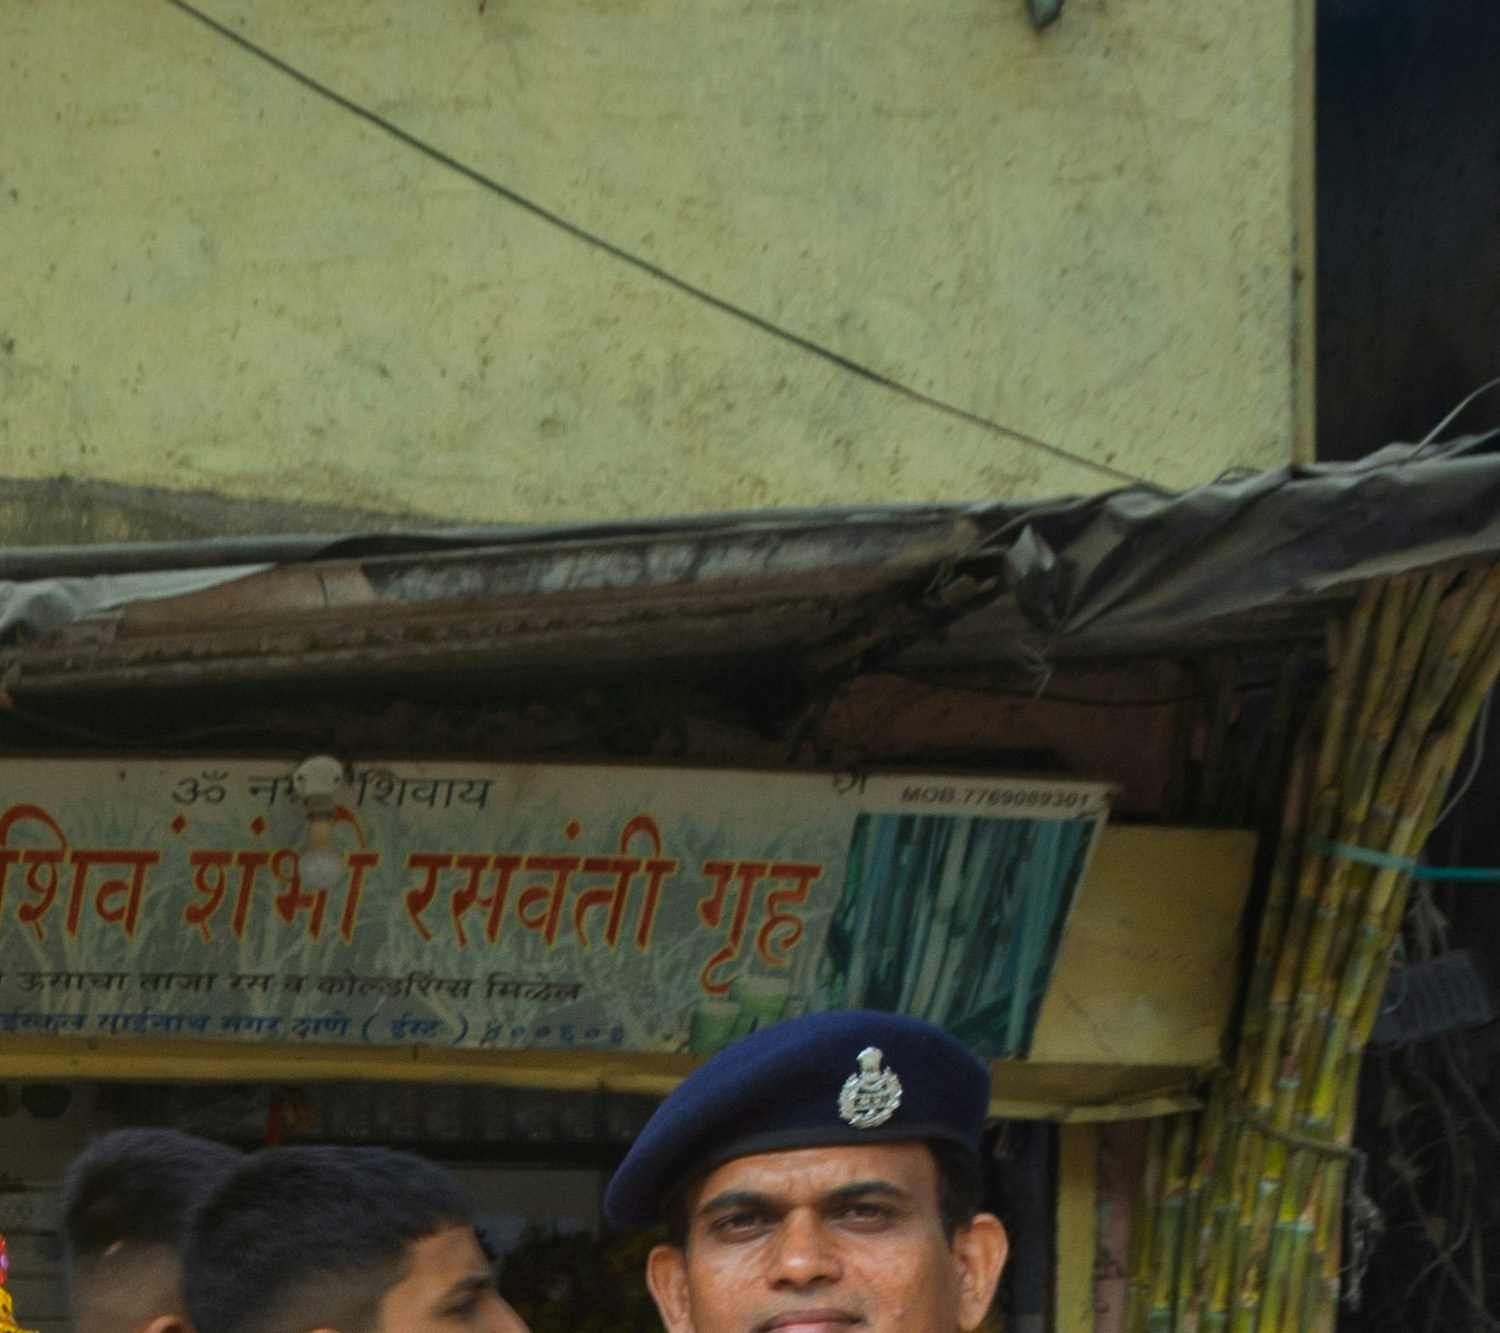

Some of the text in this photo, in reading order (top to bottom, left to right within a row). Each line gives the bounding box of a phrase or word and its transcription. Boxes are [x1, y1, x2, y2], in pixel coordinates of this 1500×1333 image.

[171, 769, 229, 805] ॐ
[354, 768, 495, 809] शिवाय
[403, 813, 678, 955] रसवंती
[698, 857, 825, 998] गृह
[138, 970, 218, 994] ताजा
[229, 971, 274, 994] रस
[283, 973, 304, 995] व
